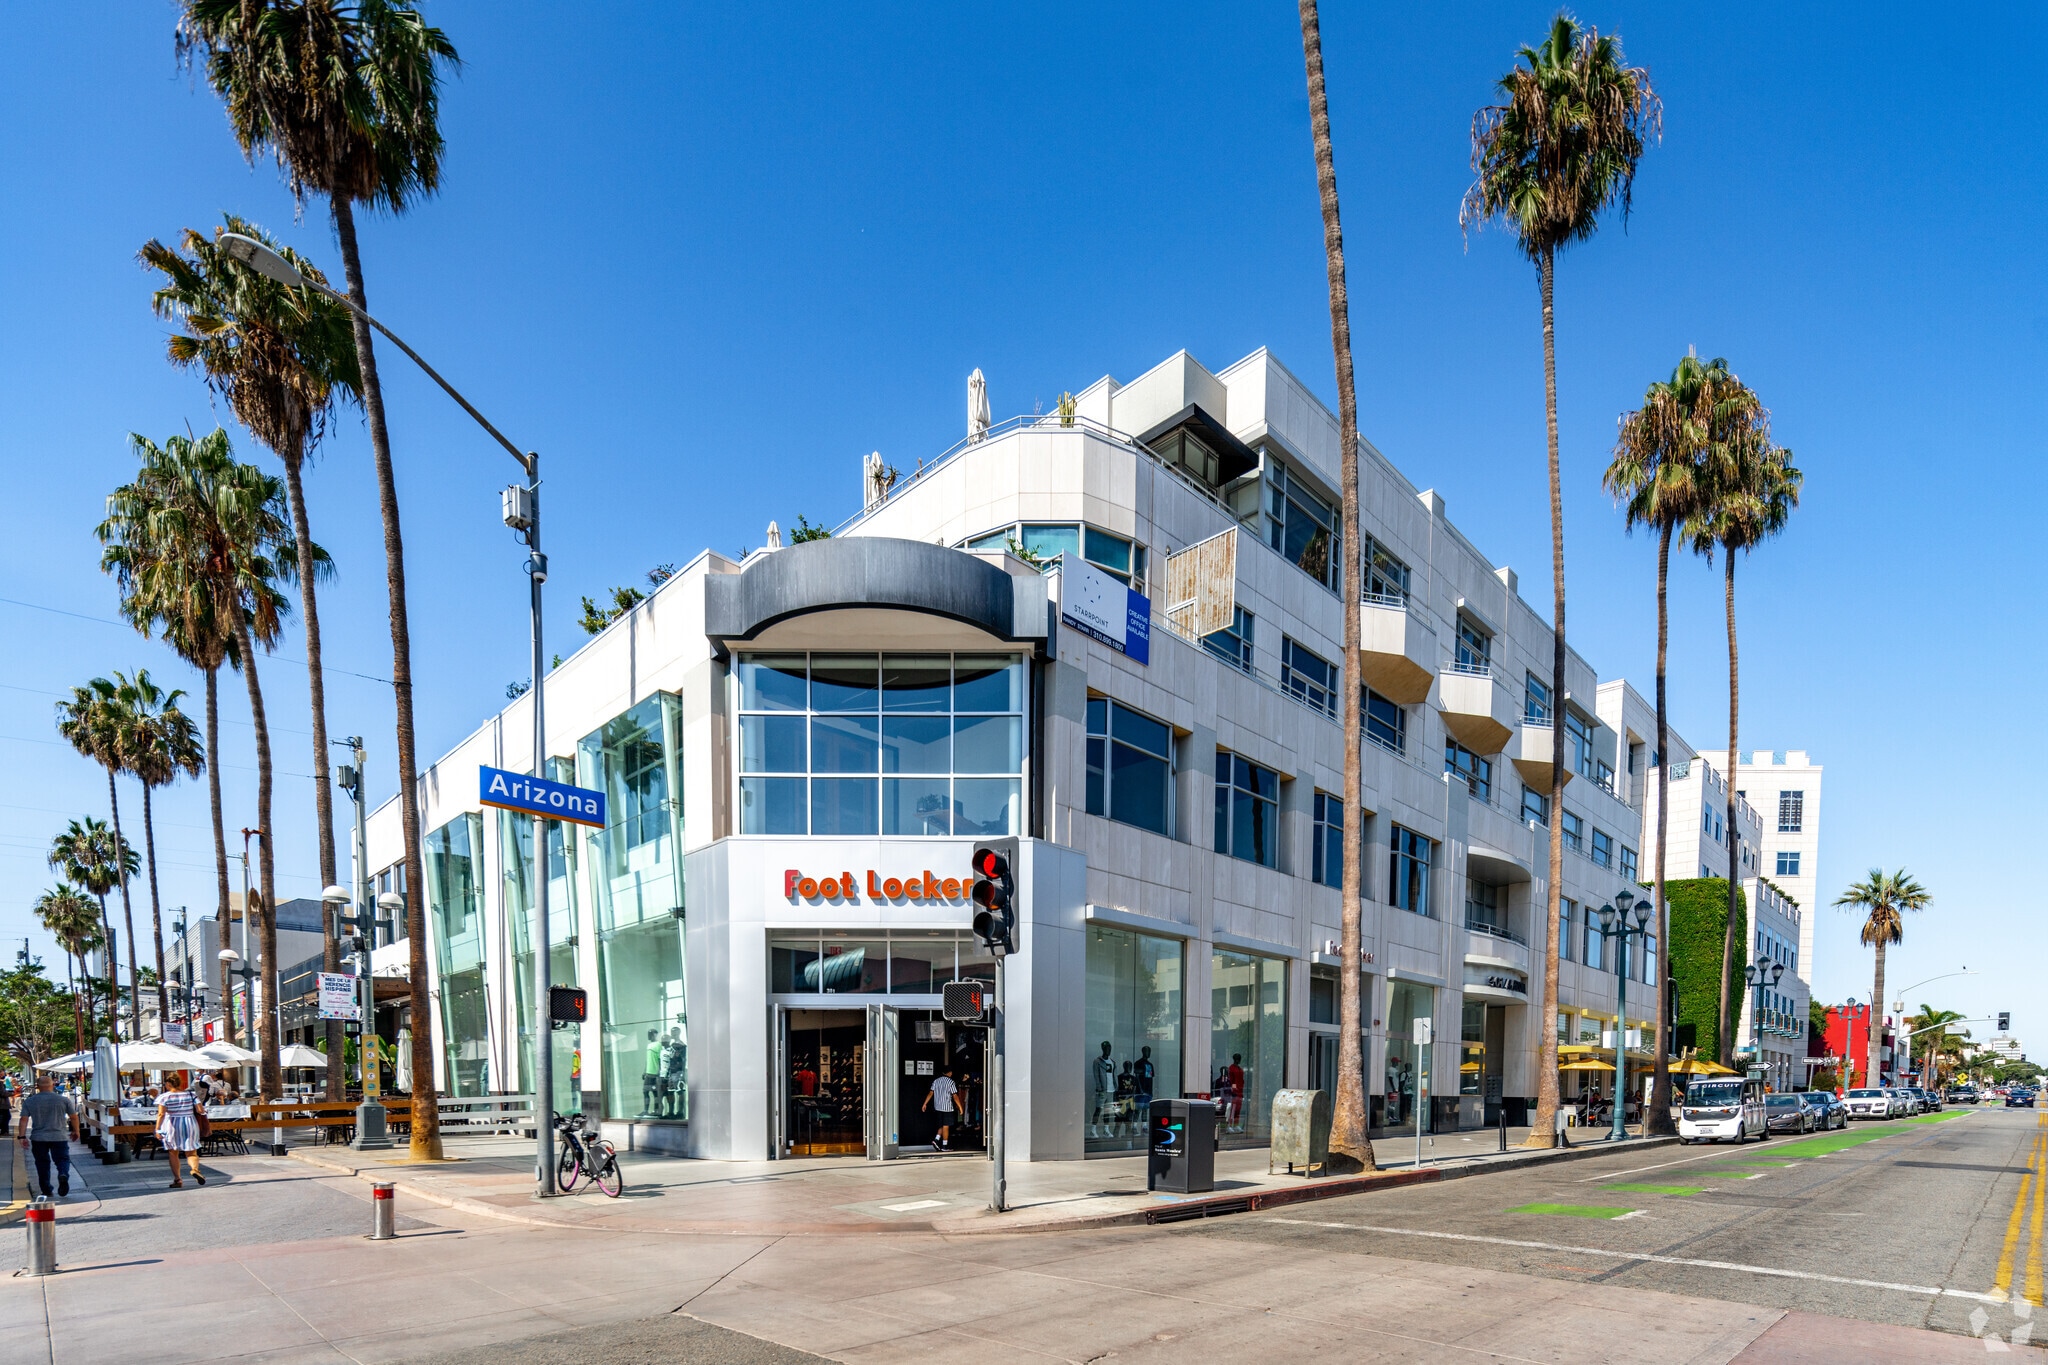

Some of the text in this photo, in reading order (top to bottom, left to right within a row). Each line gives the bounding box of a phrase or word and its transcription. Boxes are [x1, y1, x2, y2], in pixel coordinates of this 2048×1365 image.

[488, 773, 598, 815] Arizona
[785, 869, 974, 899] Foot Locker
[574, 997, 585, 1017] 4
[971, 992, 981, 1013] 4
